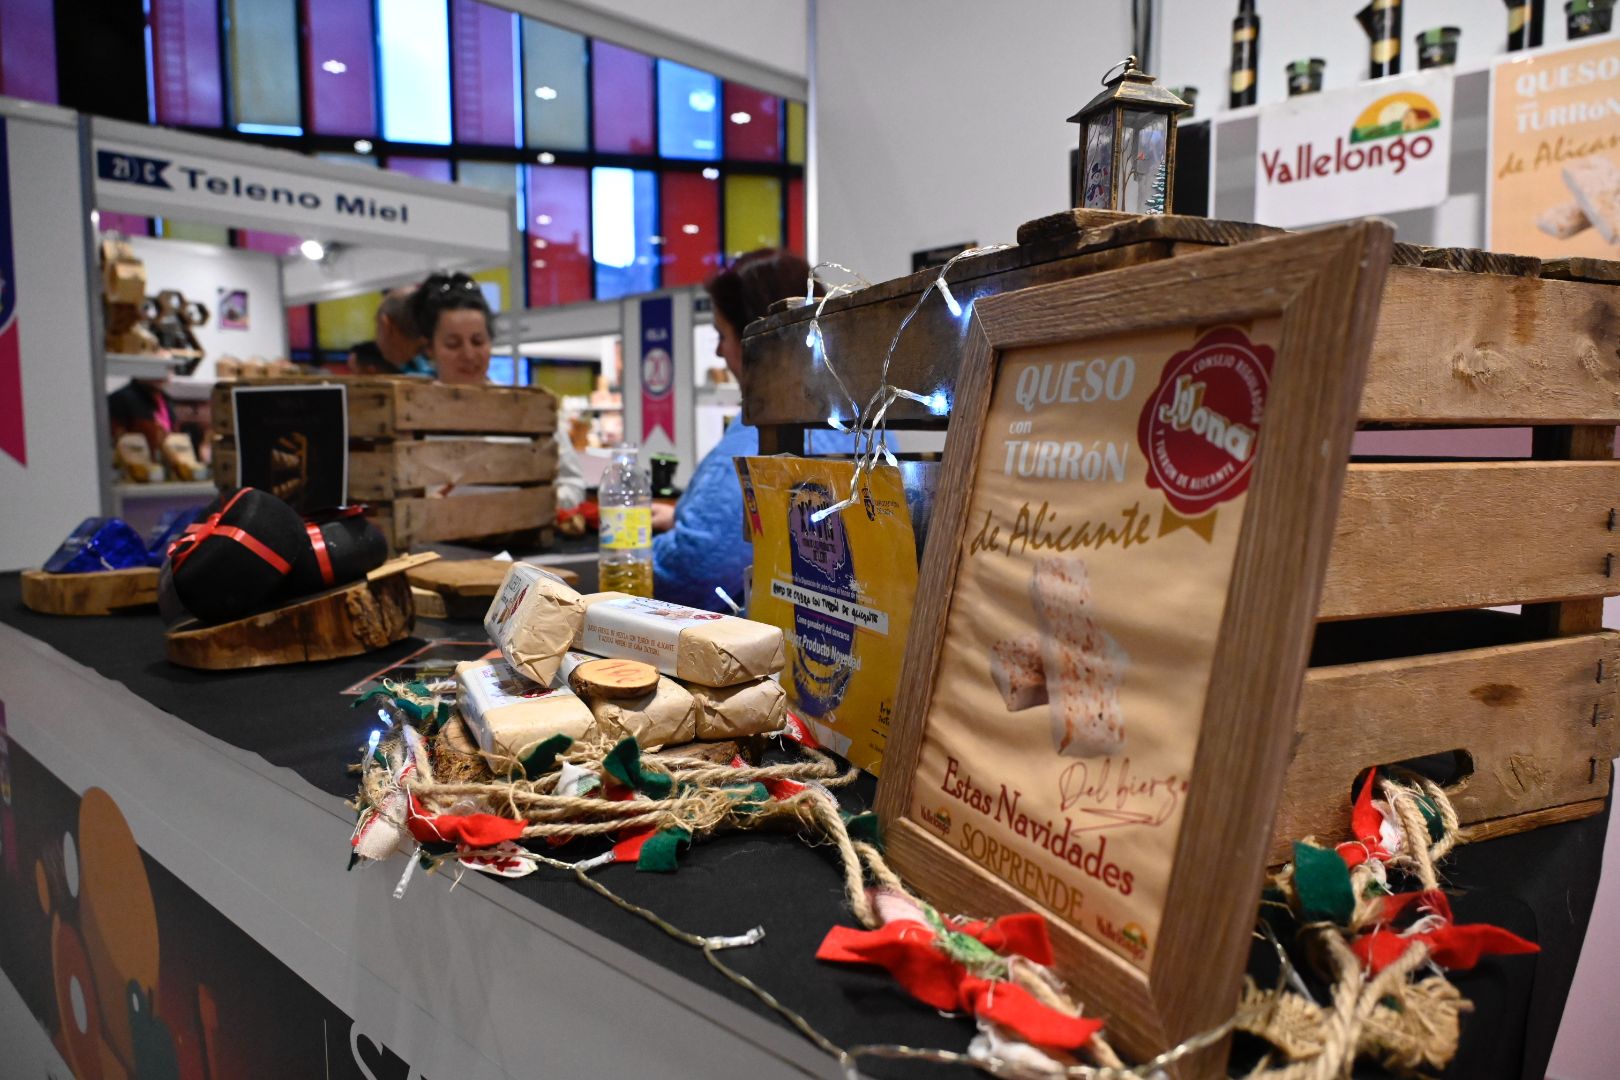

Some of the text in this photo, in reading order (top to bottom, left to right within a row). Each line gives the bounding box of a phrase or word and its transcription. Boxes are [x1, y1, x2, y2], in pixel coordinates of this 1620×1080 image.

[1516, 56, 1620, 97] QUESO
[1262, 136, 1433, 184] Vallelongo
[178, 165, 408, 223] Teleno Miel
[1015, 355, 1136, 413] QUESO
[1009, 420, 1033, 434] con
[970, 501, 1151, 557] de Alicante
[802, 635, 831, 658] Producto
[940, 756, 1135, 897] Estas Navidades
[960, 822, 1085, 928] SORPRENDE
